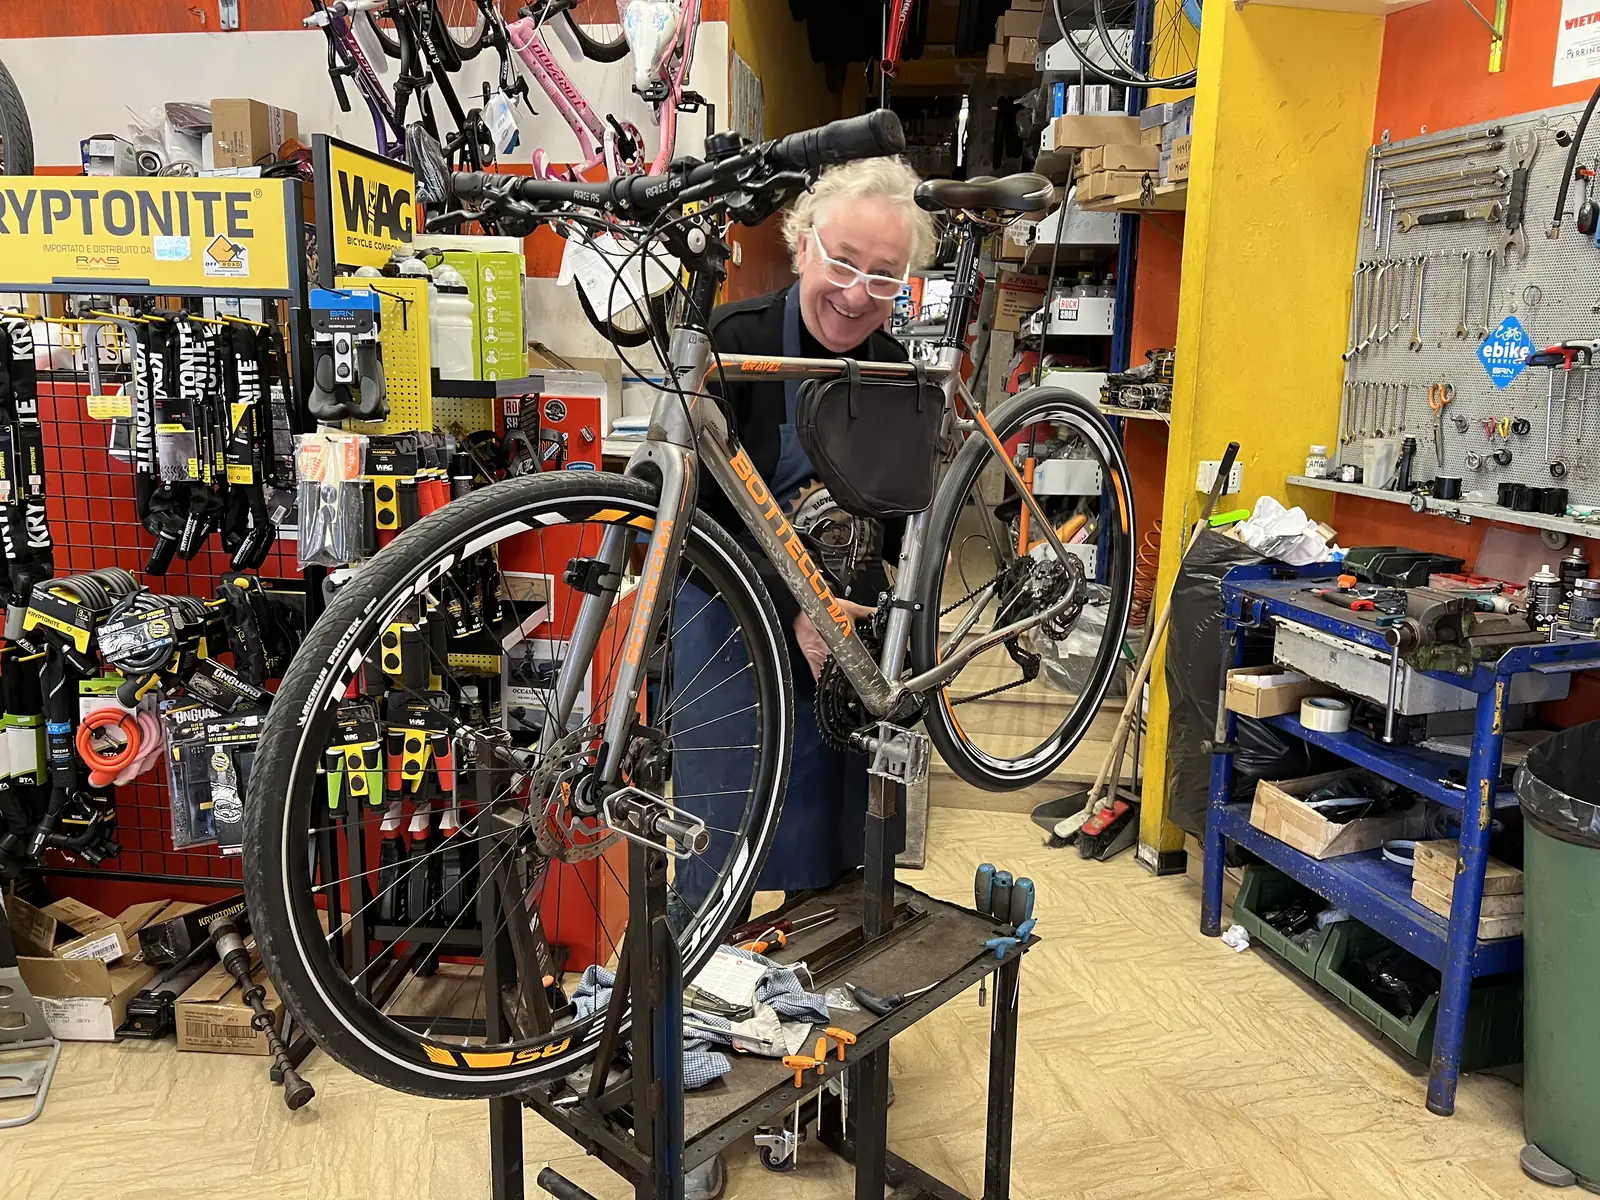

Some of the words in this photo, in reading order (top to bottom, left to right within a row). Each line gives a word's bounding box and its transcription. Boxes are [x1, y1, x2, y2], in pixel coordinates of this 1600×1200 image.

[532, 43, 587, 114] TORPADO
[338, 170, 412, 243] WAG
[43, 244, 84, 252] IMPORTATO
[86, 245, 91, 253] E
[93, 245, 138, 254] DISTRIBUITO
[140, 246, 152, 254] DA
[347, 236, 373, 249] BICYCLE
[1007, 276, 1038, 286] KENDA
[1060, 298, 1079, 309] ROCK
[1060, 309, 1078, 320] SHOX
[1483, 341, 1530, 358] ebike
[741, 360, 782, 371] GRAVEL
[507, 417, 520, 428] SH
[730, 449, 852, 637] BOTTECCHIA
[626, 520, 674, 666] BOTTECCHIA
[27, 610, 61, 628] KRYPTONITE
[327, 617, 363, 665] PROTEK
[301, 668, 328, 715] MICHELIN
[409, 718, 425, 726] WAG
[198, 902, 245, 927] KRYPTONITE
